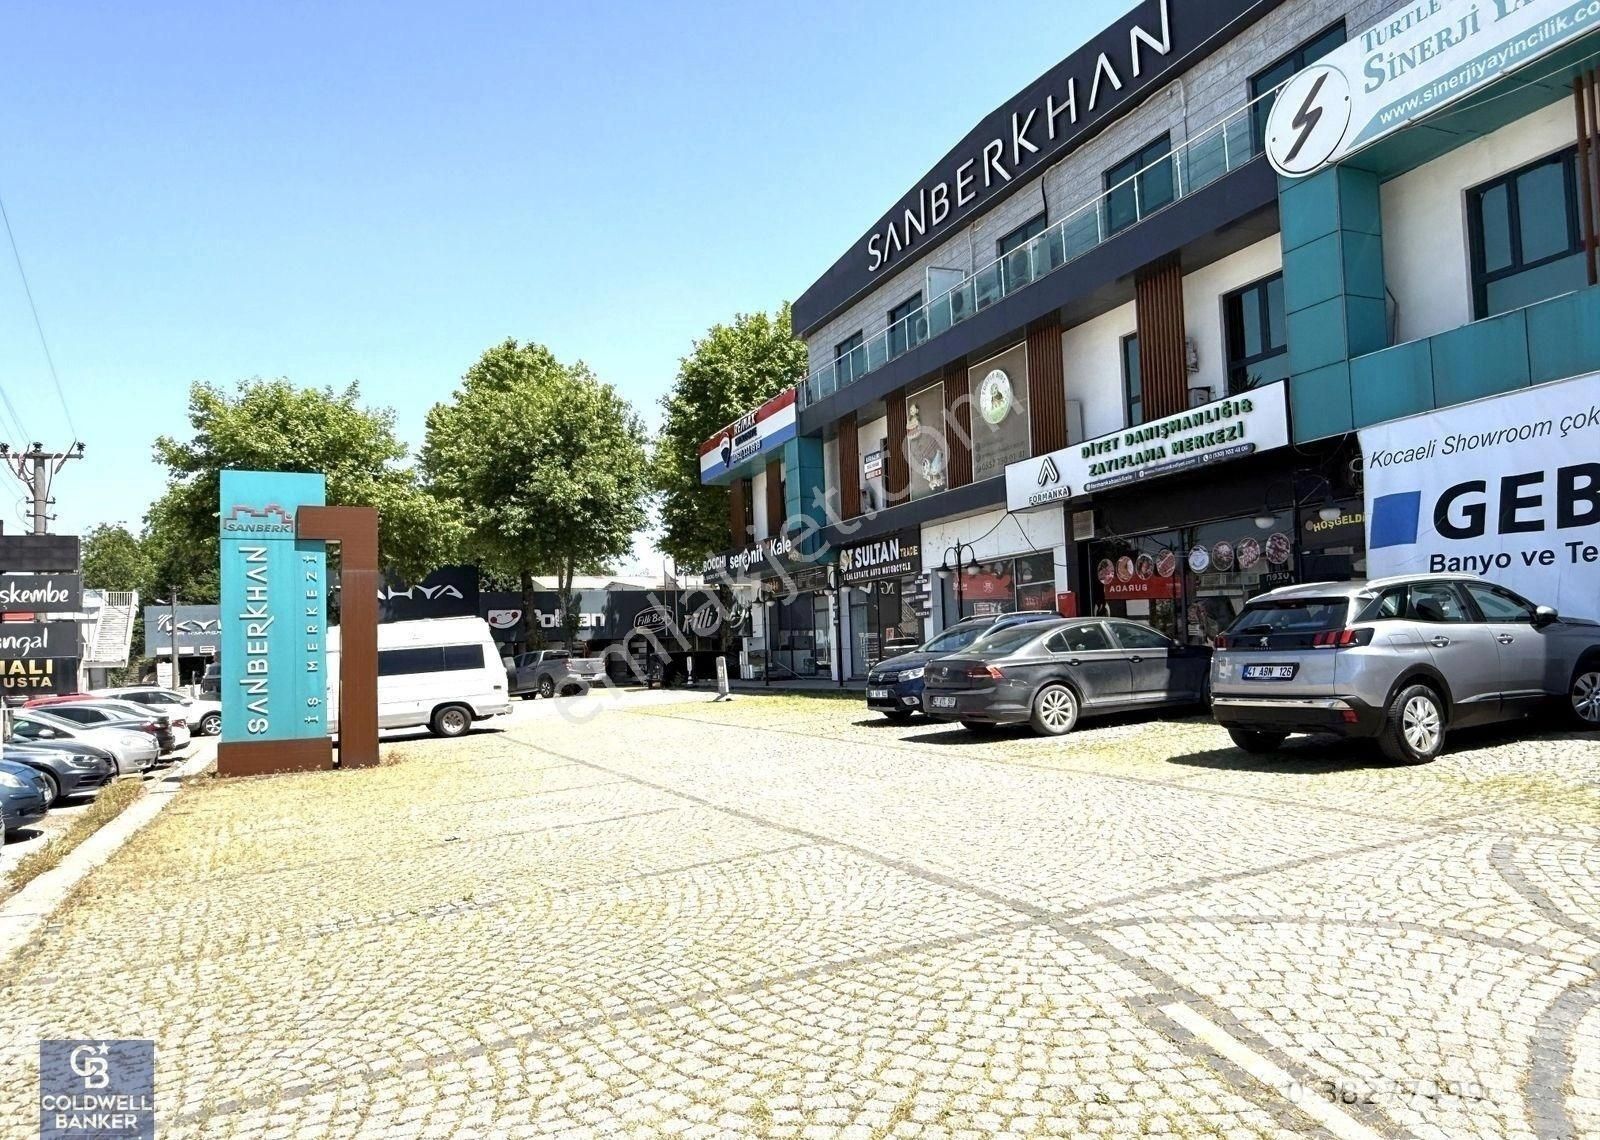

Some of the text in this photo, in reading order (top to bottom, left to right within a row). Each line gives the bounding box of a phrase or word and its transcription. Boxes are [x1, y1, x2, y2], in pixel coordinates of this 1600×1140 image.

[1364, 4, 1480, 94] SİNERJİ
[867, 0, 1175, 272] SANBERKHAN
[1081, 436, 1120, 459] DİYET
[1088, 421, 1245, 477] ZAYIFLAMA MERKEZİ
[1369, 405, 1600, 469] Kocaeli Showroom çok
[1028, 486, 1069, 504] FORMANKA
[1433, 462, 1600, 540] GEB
[227, 523, 290, 533] SANBERK
[770, 536, 792, 557] Kale
[855, 538, 900, 568] SULTAN
[1429, 551, 1512, 576] Banyo
[1522, 548, 1555, 567] ve
[0, 627, 48, 657] ngal
[239, 545, 274, 735] SANBERKHAN
[303, 554, 319, 725] İŞ MERKEZİ
[3, 677, 53, 688] USTA
[1279, 666, 1292, 676] 126
